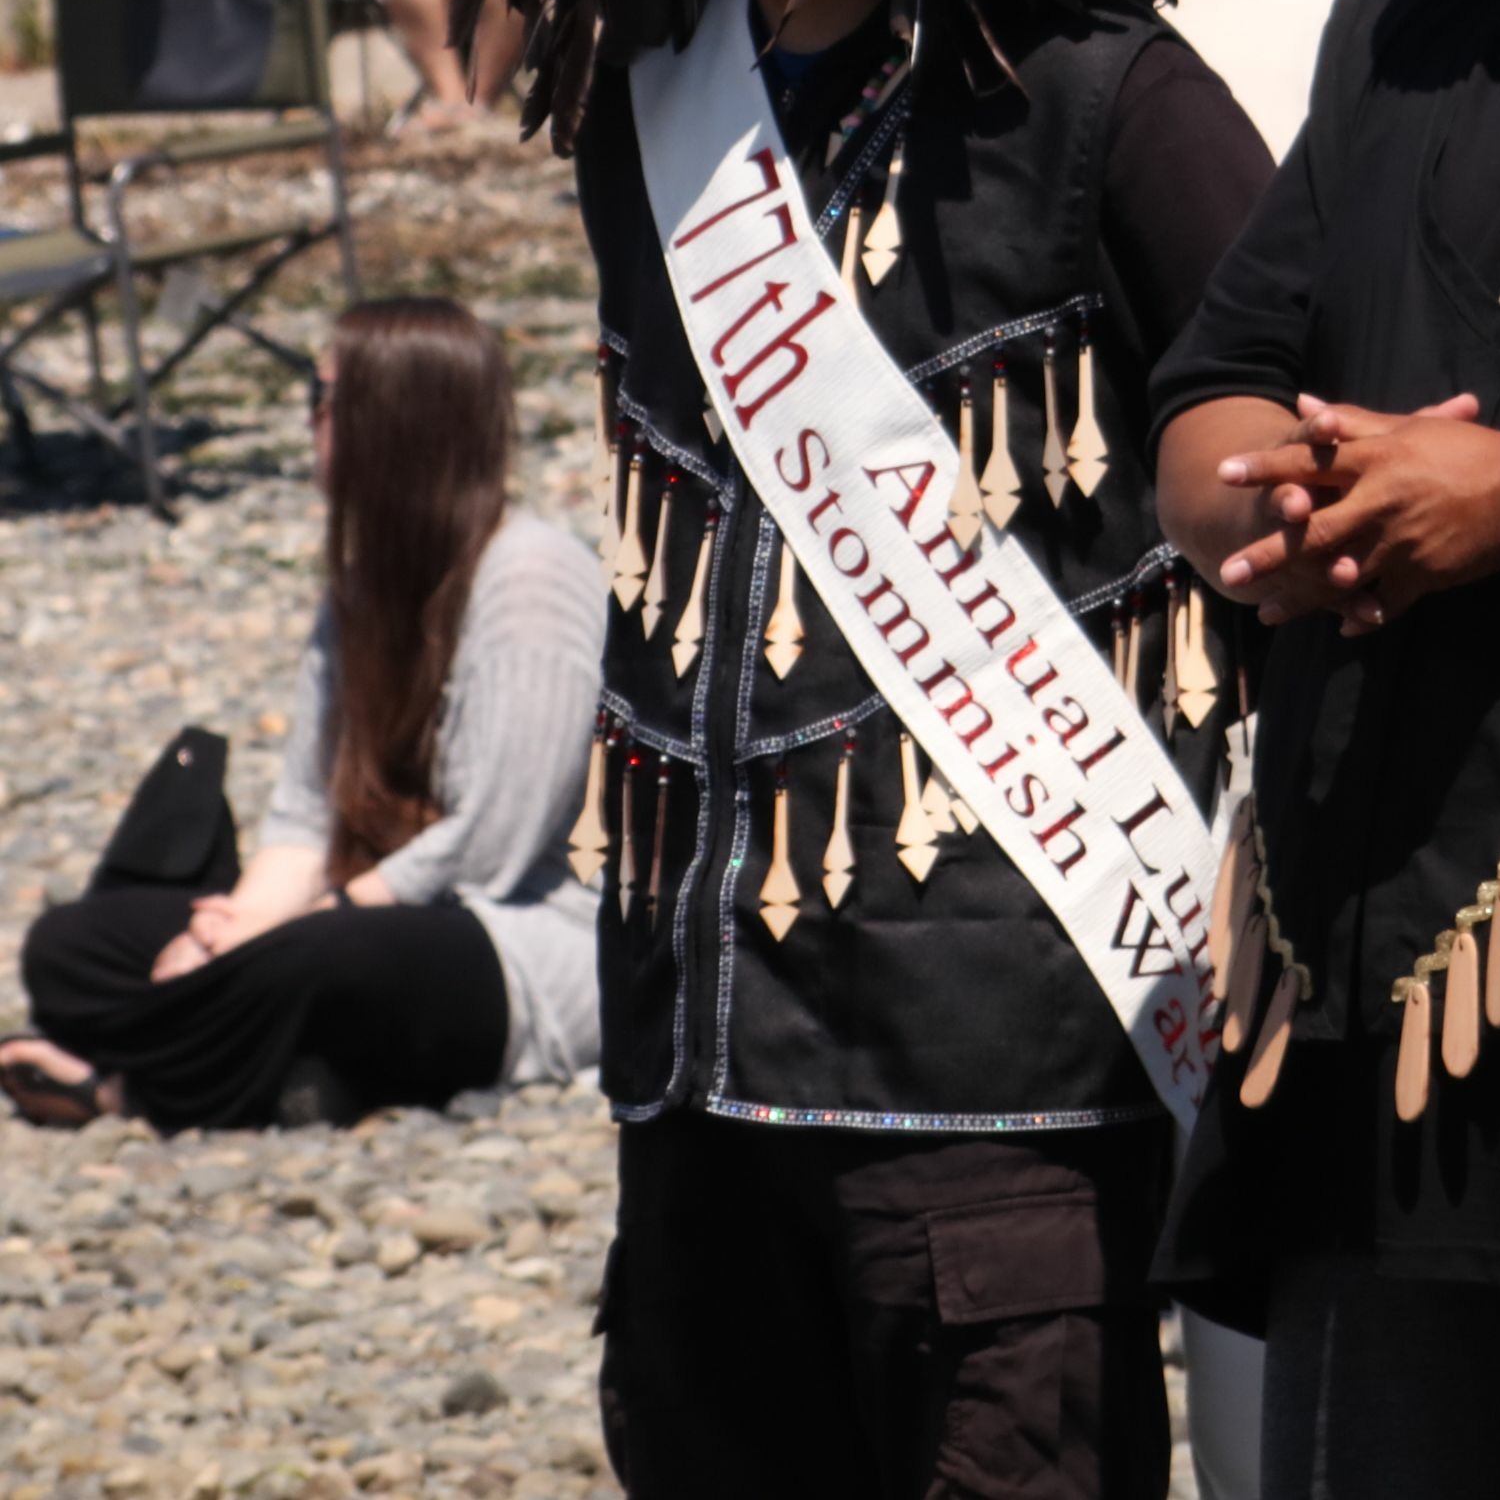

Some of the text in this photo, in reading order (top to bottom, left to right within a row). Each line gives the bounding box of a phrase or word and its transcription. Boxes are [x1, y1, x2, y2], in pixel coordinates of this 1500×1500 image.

[673, 147, 837, 432] 77th
[861, 458, 1128, 780] Annual
[773, 428, 1088, 881] Stommish
